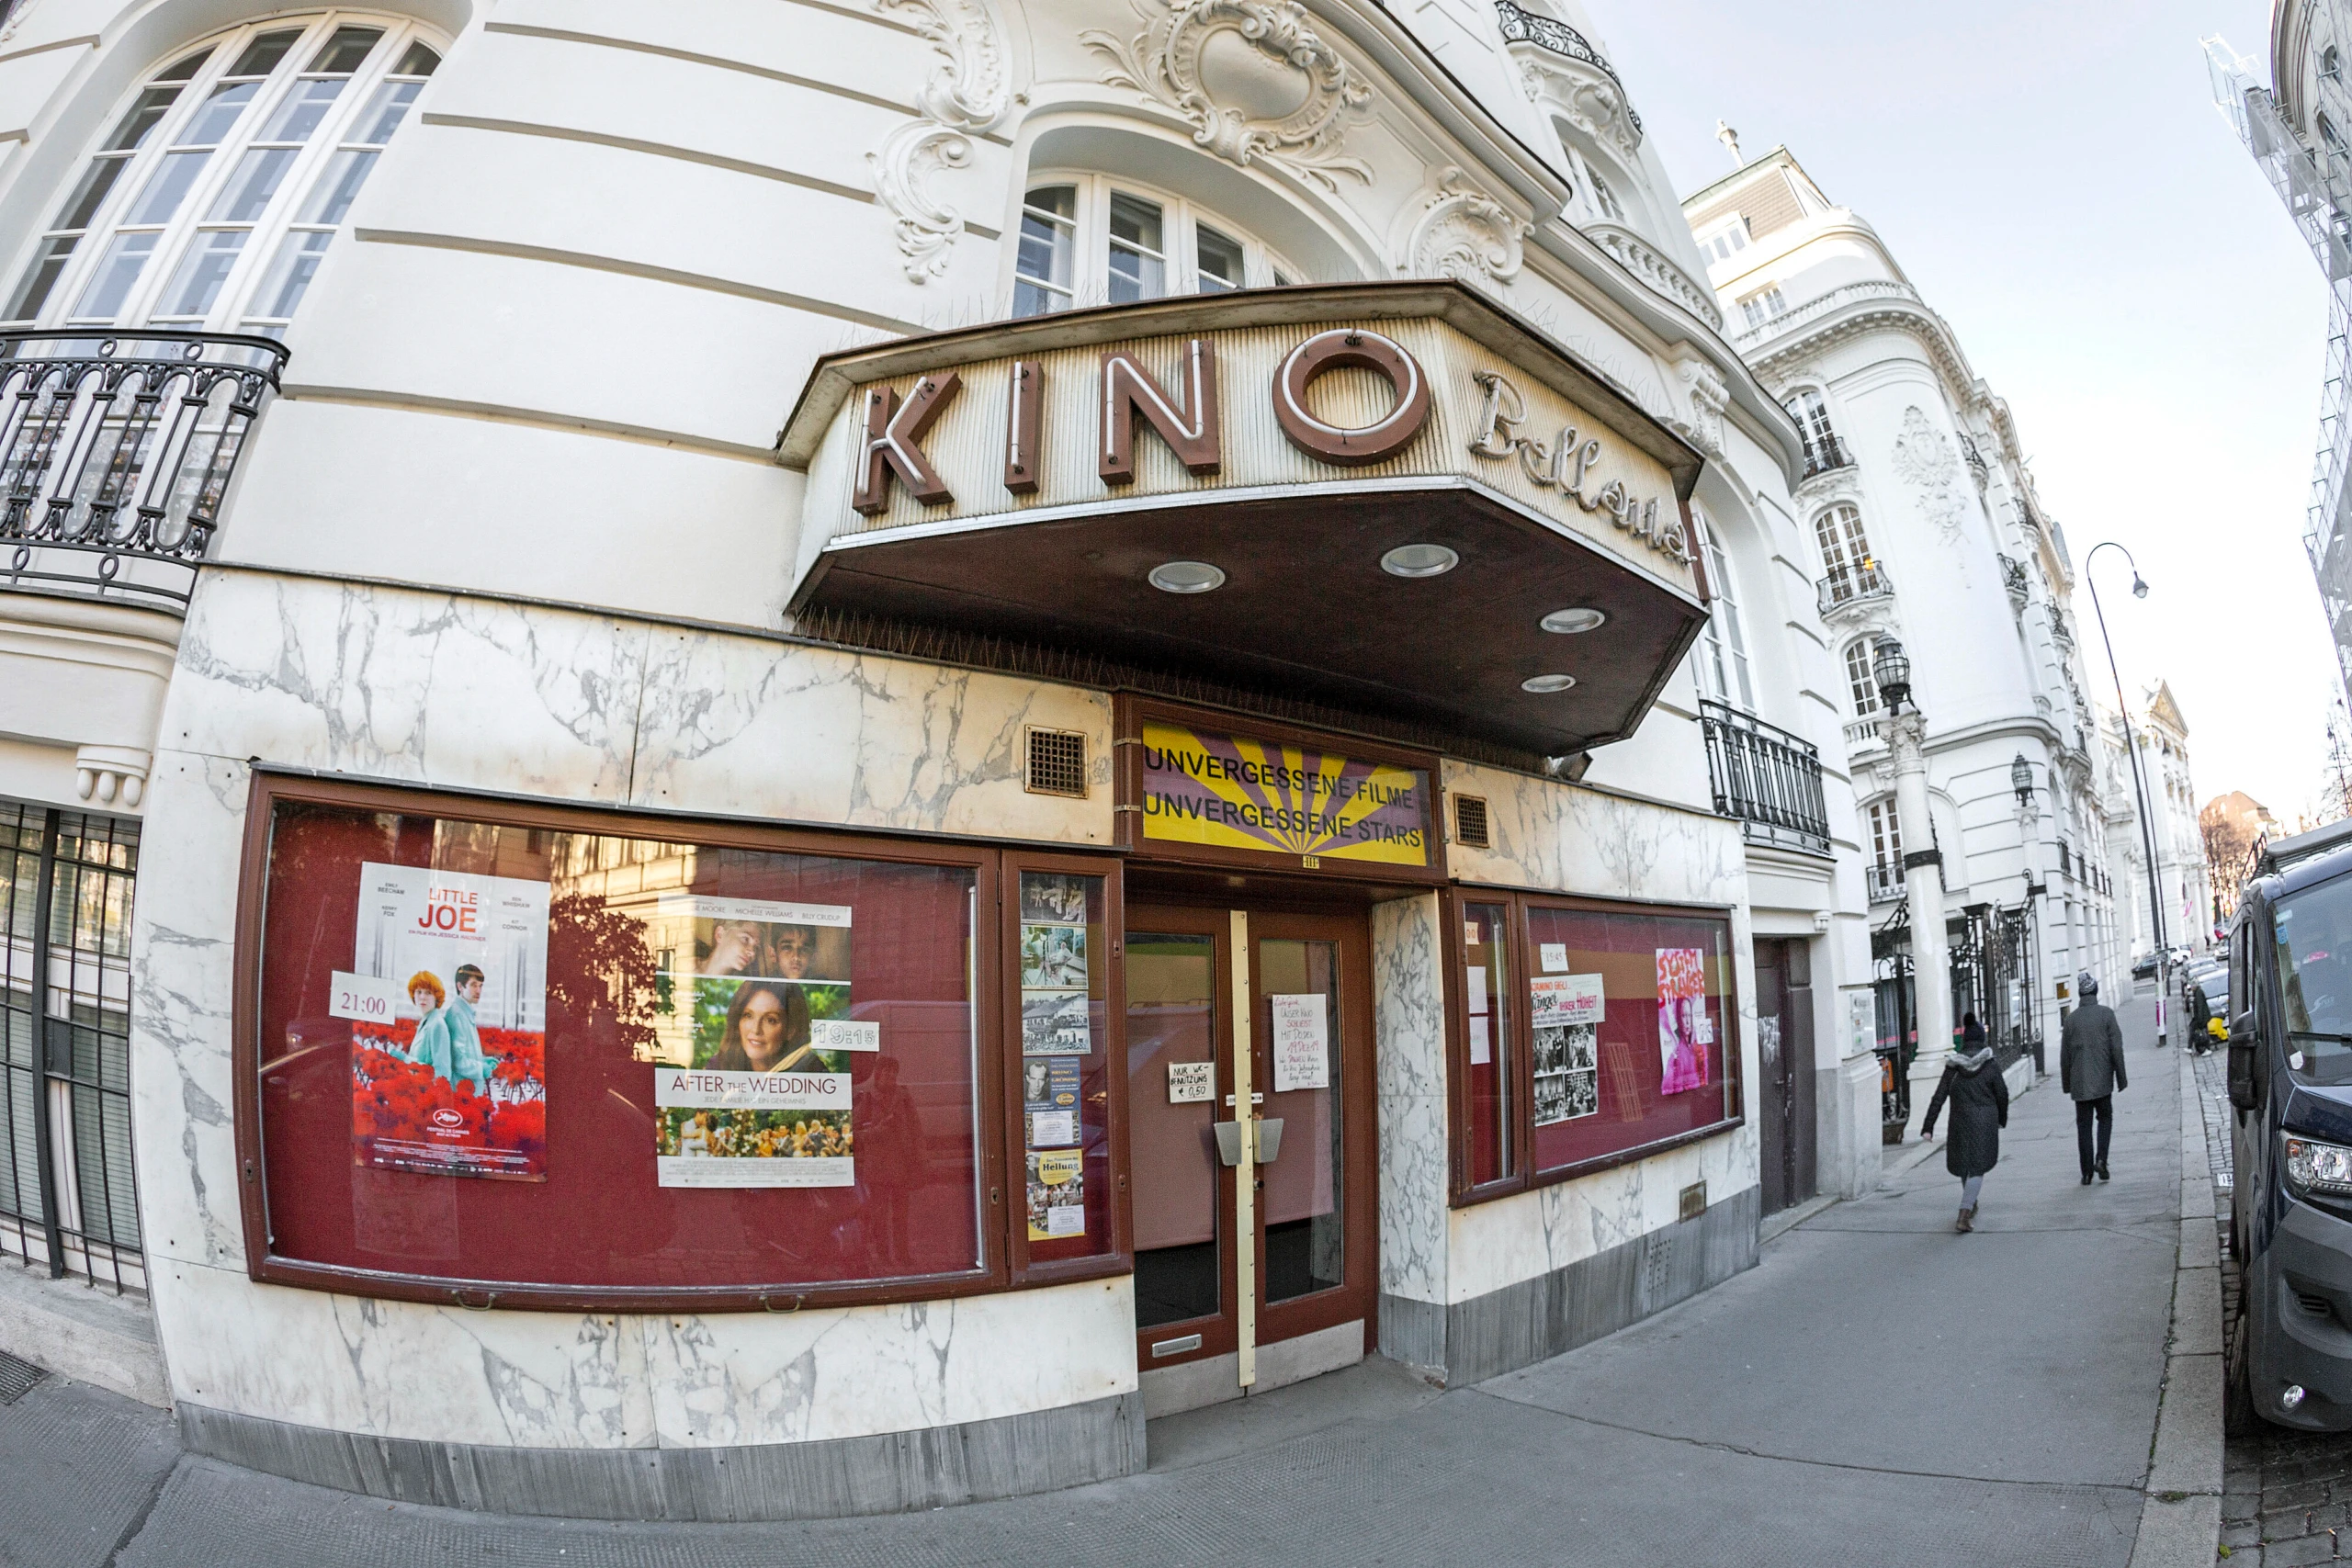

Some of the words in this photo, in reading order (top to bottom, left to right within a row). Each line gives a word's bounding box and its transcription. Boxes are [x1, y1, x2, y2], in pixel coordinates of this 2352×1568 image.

[852, 326, 1431, 517] KINO
[1470, 368, 1699, 567] Bellaria
[1145, 747, 1353, 799] UNVERGESSENE
[1357, 780, 1415, 810] FILME
[1142, 790, 1353, 839] UNVERGESSENE
[1358, 818, 1421, 849] STARS
[429, 887, 479, 906] LITTLE
[418, 904, 477, 933] JOE
[701, 906, 726, 914] MOORE
[735, 908, 763, 917] MICHELLE
[764, 909, 794, 919] WILLIAMS
[341, 992, 386, 1015] 21:00
[813, 1022, 876, 1045] 19:15
[1170, 1074, 1208, 1086] BENUTZUNG
[1173, 1066, 1188, 1077] NUR
[672, 1075, 724, 1092] AFTER
[727, 1082, 747, 1094] THE
[748, 1077, 837, 1095] WEDDING
[1188, 1085, 1206, 1098] 0,50
[1043, 1163, 1080, 1171] Heilung
